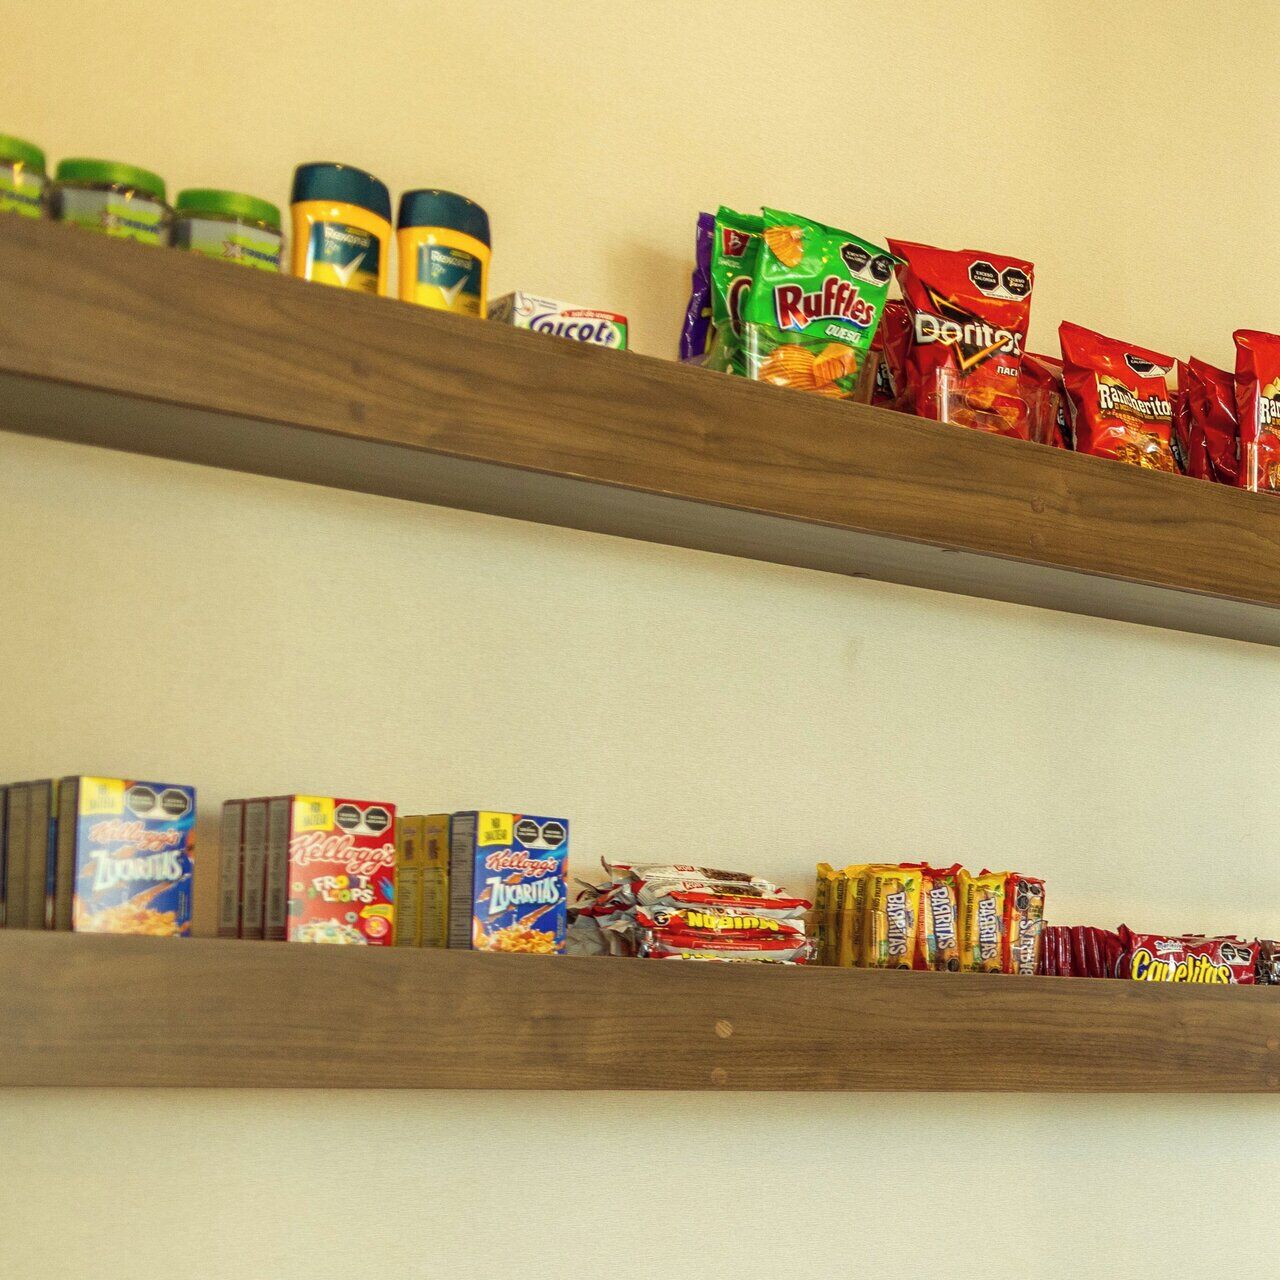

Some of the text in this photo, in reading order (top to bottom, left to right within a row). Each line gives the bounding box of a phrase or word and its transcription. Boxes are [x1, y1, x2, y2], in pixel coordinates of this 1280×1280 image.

[775, 277, 877, 332] Ruffles
[825, 325, 862, 342] QUESO
[915, 312, 1022, 356] Doritos
[484, 850, 560, 879] Kellogg's
[486, 876, 562, 916] ZUCARITAS
[930, 885, 957, 949] BARRITAS
[886, 891, 907, 955] BARRITAS
[978, 897, 998, 960] BARRITAS
